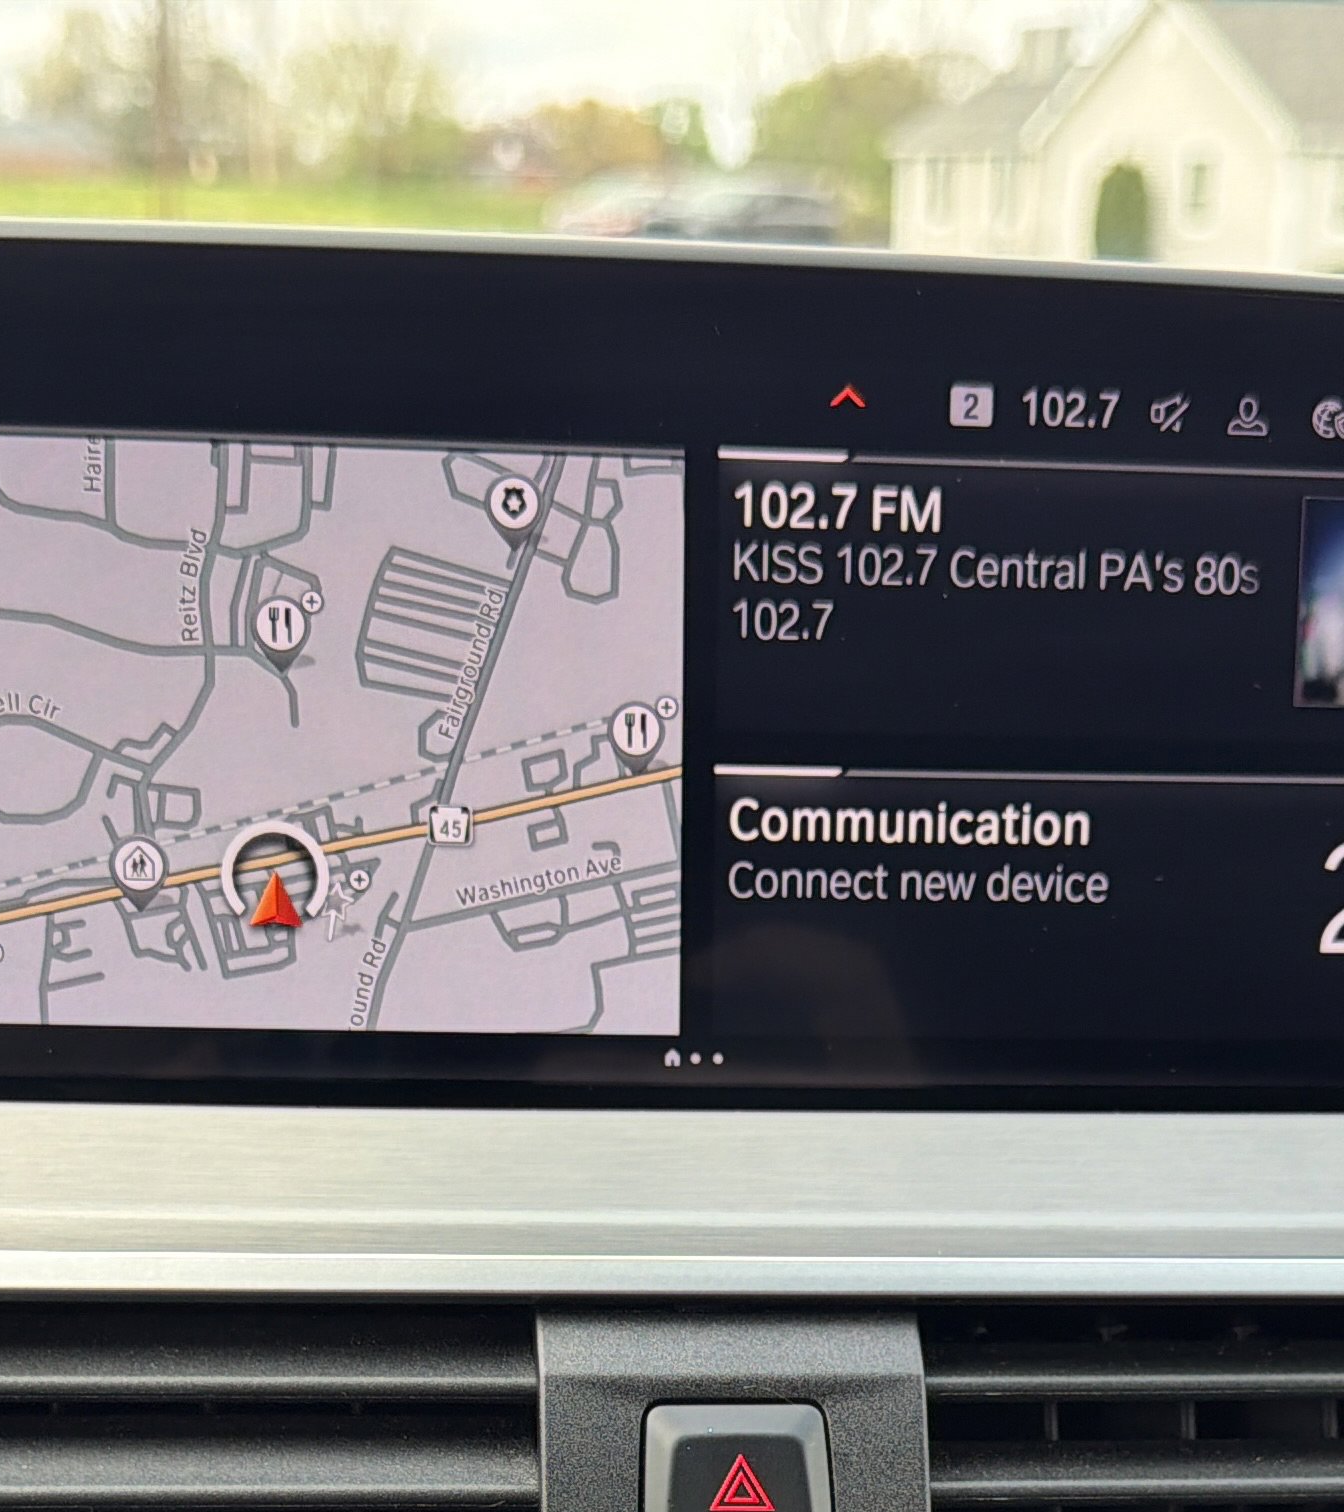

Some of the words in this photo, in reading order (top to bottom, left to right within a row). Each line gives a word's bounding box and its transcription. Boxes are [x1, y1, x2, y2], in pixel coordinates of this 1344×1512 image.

[963, 394, 980, 421] 2
[1021, 388, 1121, 429] 102.7
[733, 481, 858, 531] 102.7
[871, 484, 943, 534] FM
[180, 528, 207, 577] Blvd
[732, 540, 824, 585] KISS
[837, 544, 939, 587] 102.7
[950, 549, 1087, 590] Central
[1099, 551, 1186, 594] PA's
[1194, 555, 1260, 596] 80s
[180, 581, 202, 643] Reitz
[732, 599, 835, 642] 102.7
[438, 623, 492, 740] Fairground
[479, 588, 504, 621] Rd
[28, 694, 61, 719] Cir
[439, 819, 464, 839] 45
[727, 796, 1091, 847] Communication
[455, 868, 581, 907] Washington
[585, 855, 622, 882] Ave
[727, 859, 889, 902] Connect
[899, 869, 977, 902] new
[986, 862, 1110, 904] device
[348, 971, 375, 1031] ound
[362, 938, 387, 969] Rd
